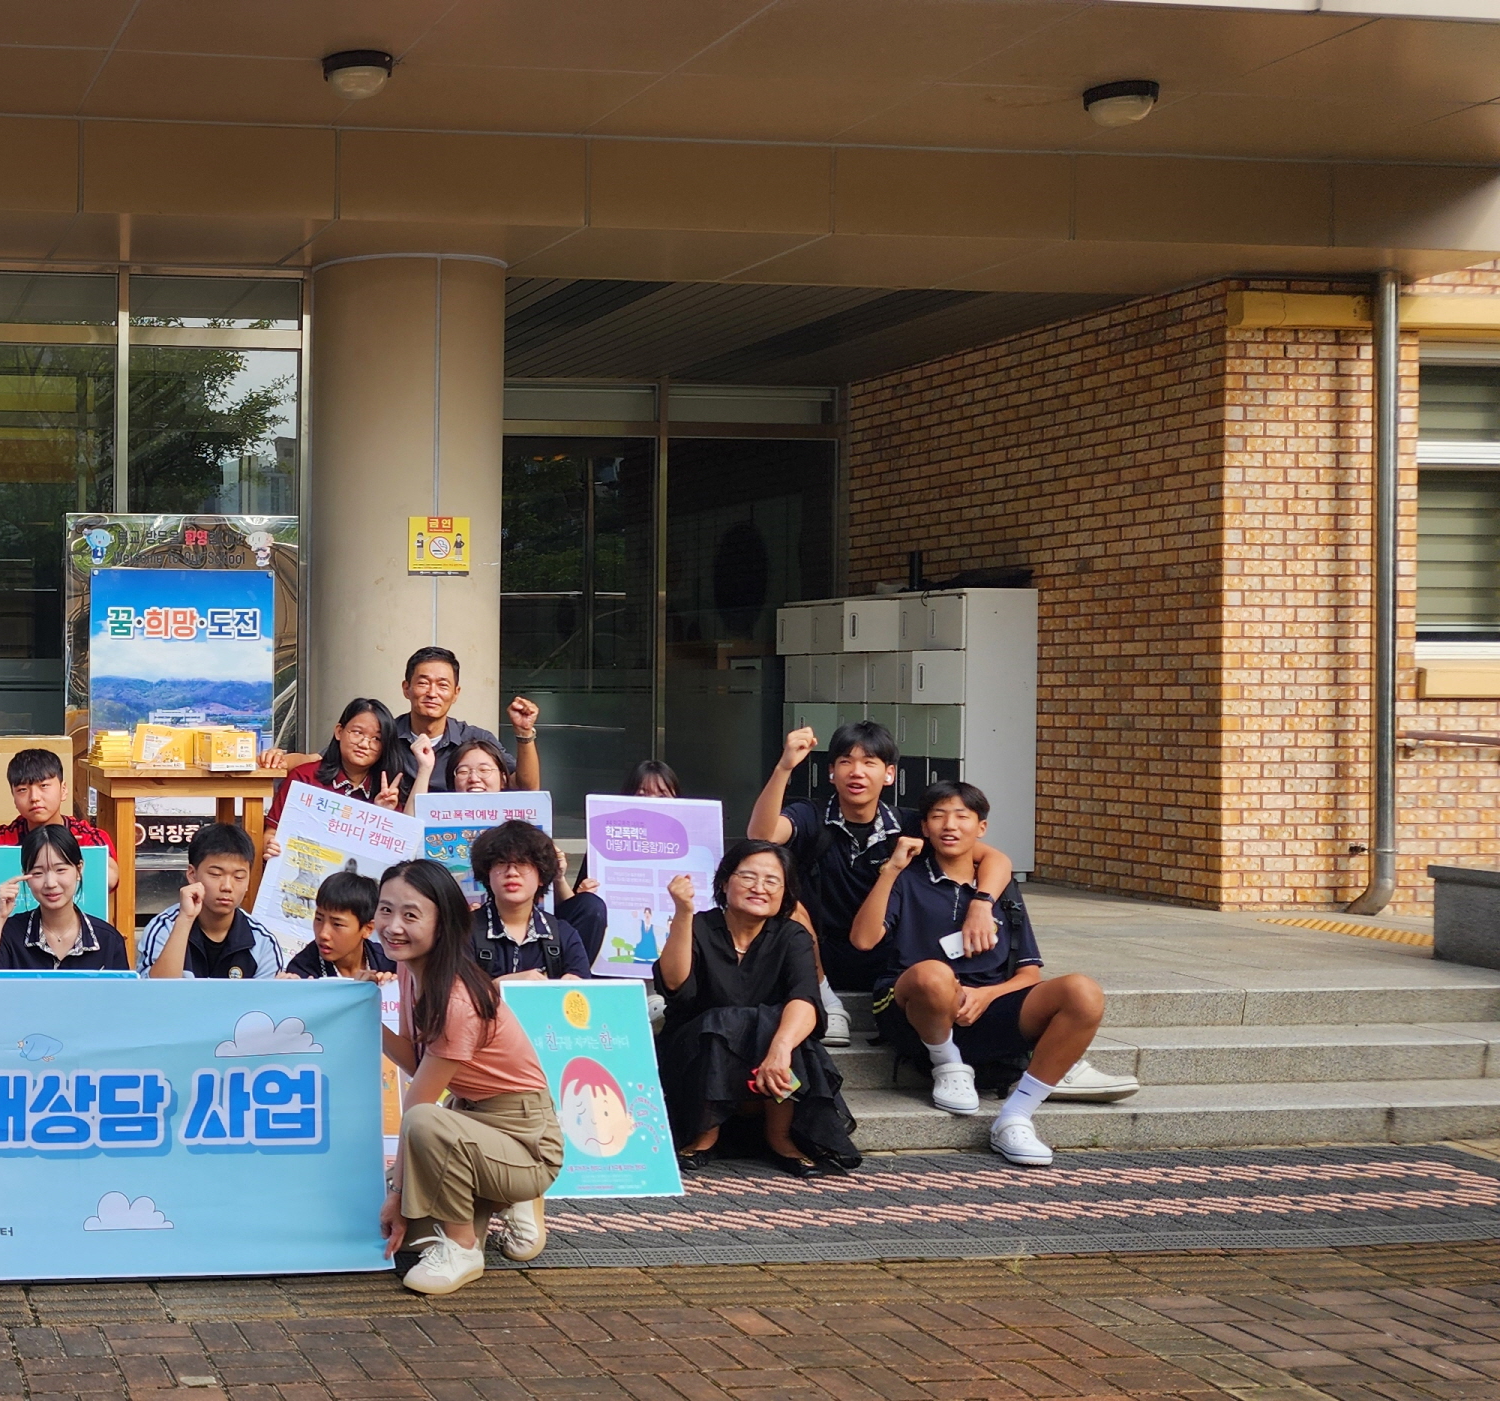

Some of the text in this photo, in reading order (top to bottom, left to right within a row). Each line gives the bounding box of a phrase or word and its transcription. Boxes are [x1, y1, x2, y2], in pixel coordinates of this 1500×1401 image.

[146, 530, 180, 545] 방문을
[113, 551, 246, 565] Welcome to Our School
[300, 792, 393, 832] 내 친구를 지키는
[430, 809, 537, 821] 학교폭력예방 캠페인
[328, 818, 406, 853] 한마디 캠페인
[605, 826, 648, 840] 학교폭력엔
[606, 839, 680, 854] 어떻게 대응할까요?
[184, 1069, 316, 1140] 사업
